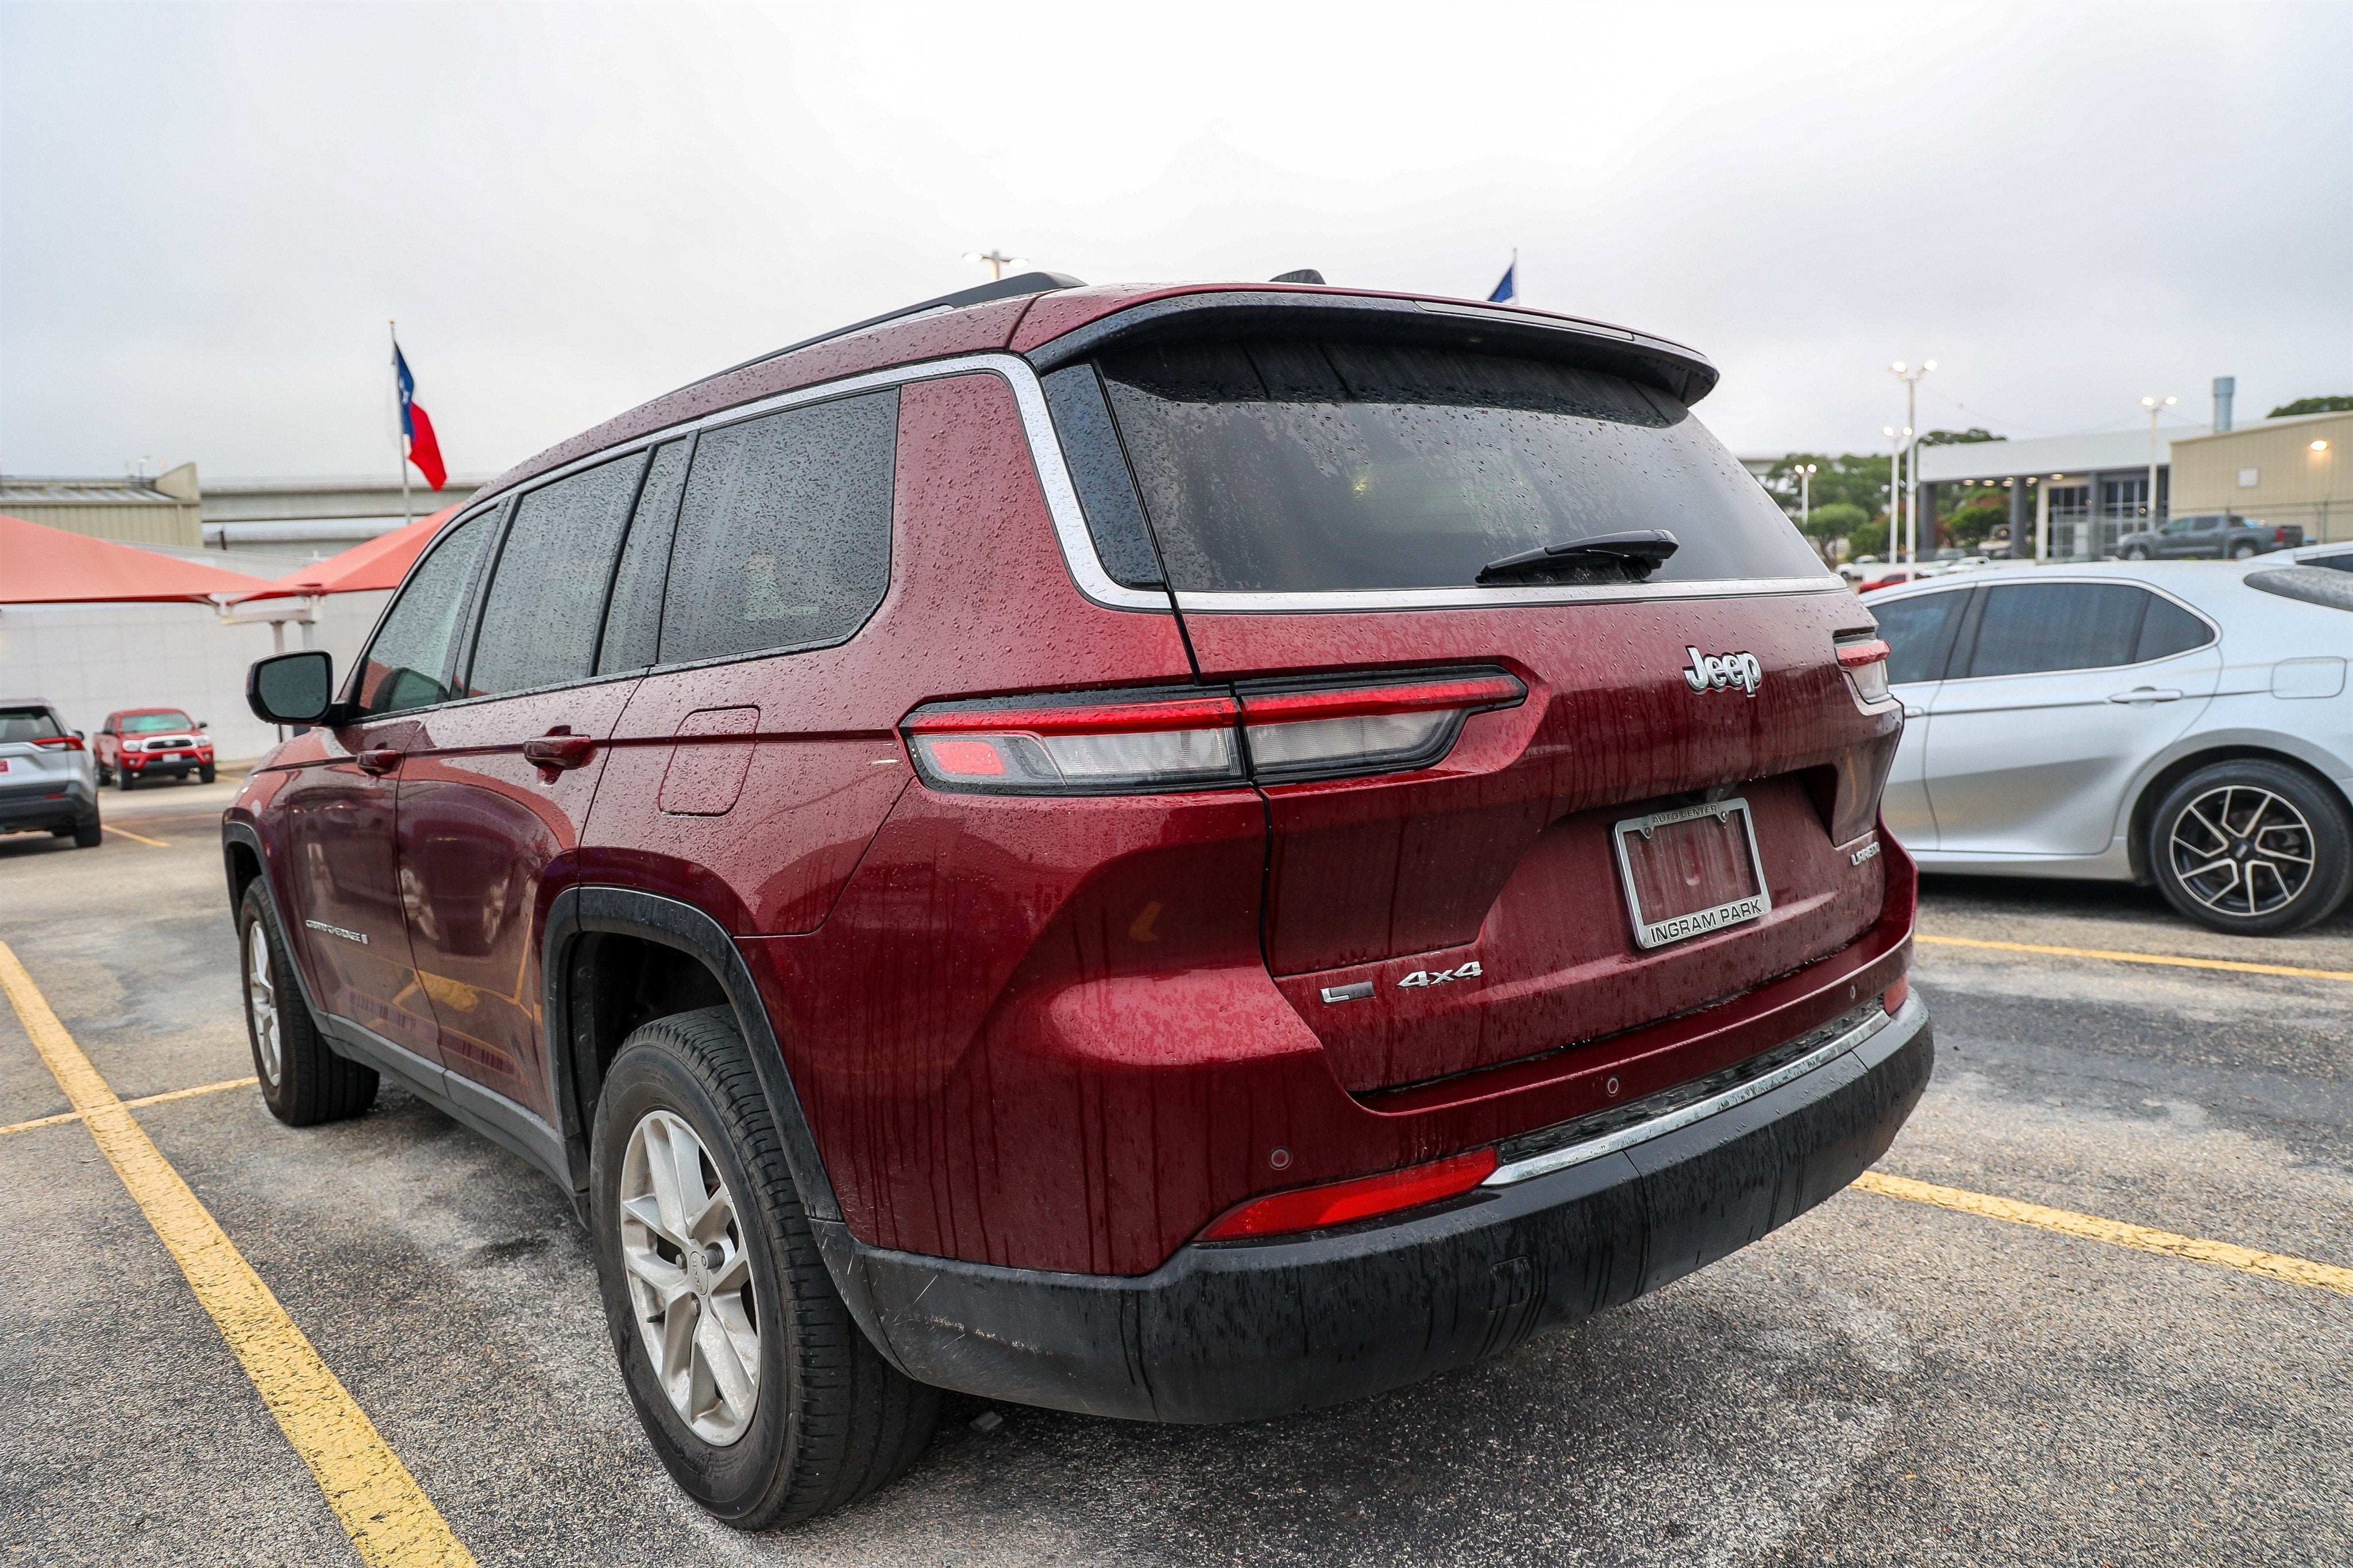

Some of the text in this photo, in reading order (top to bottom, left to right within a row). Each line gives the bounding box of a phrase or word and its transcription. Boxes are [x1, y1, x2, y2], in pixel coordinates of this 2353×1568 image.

[1683, 644, 1762, 697] Jeep
[1653, 803, 1719, 824] AUTO CENTER
[1650, 899, 1763, 943] INGRAM PARK
[1396, 960, 1483, 988] 4x4
